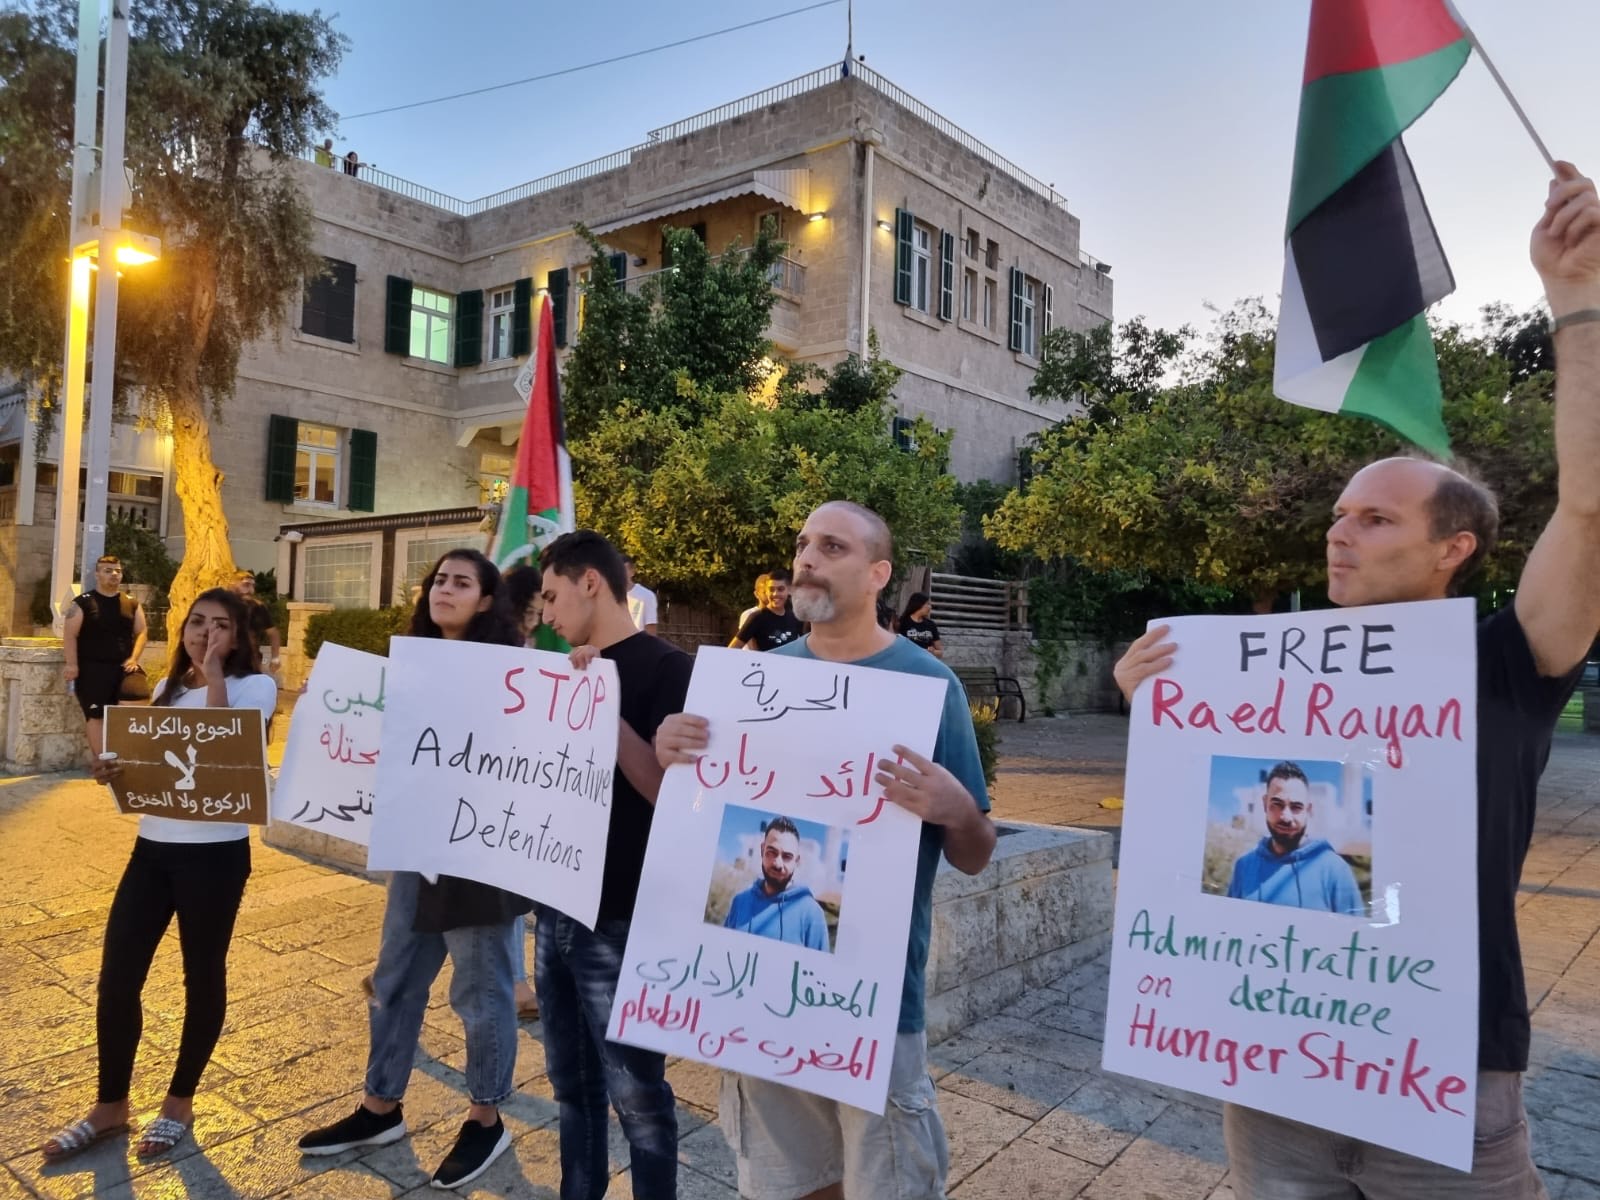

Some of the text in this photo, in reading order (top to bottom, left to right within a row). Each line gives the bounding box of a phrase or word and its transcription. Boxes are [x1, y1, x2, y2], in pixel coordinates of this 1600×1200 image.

[1240, 624, 1395, 675] FREE
[322, 665, 385, 718] طين
[503, 667, 606, 731] STOP
[737, 662, 850, 723] الحرية
[127, 716, 242, 743] الجوع والكرامة
[319, 722, 380, 764] حتلة
[1152, 677, 1463, 769] Raed Rayan
[164, 743, 198, 790] لا
[411, 726, 612, 807] Administrative
[695, 732, 776, 801] ريان
[126, 791, 252, 817] الركوع ولا الخنوع
[449, 796, 583, 872] Detentions
[636, 943, 878, 1018] المعتقل الإداري
[1129, 909, 1441, 992] Administrative
[1137, 974, 1172, 998] on
[1228, 974, 1393, 1035] detainee
[617, 981, 878, 1080] المضرب عن الطعام
[1128, 1003, 1467, 1117] Hunger Strike
